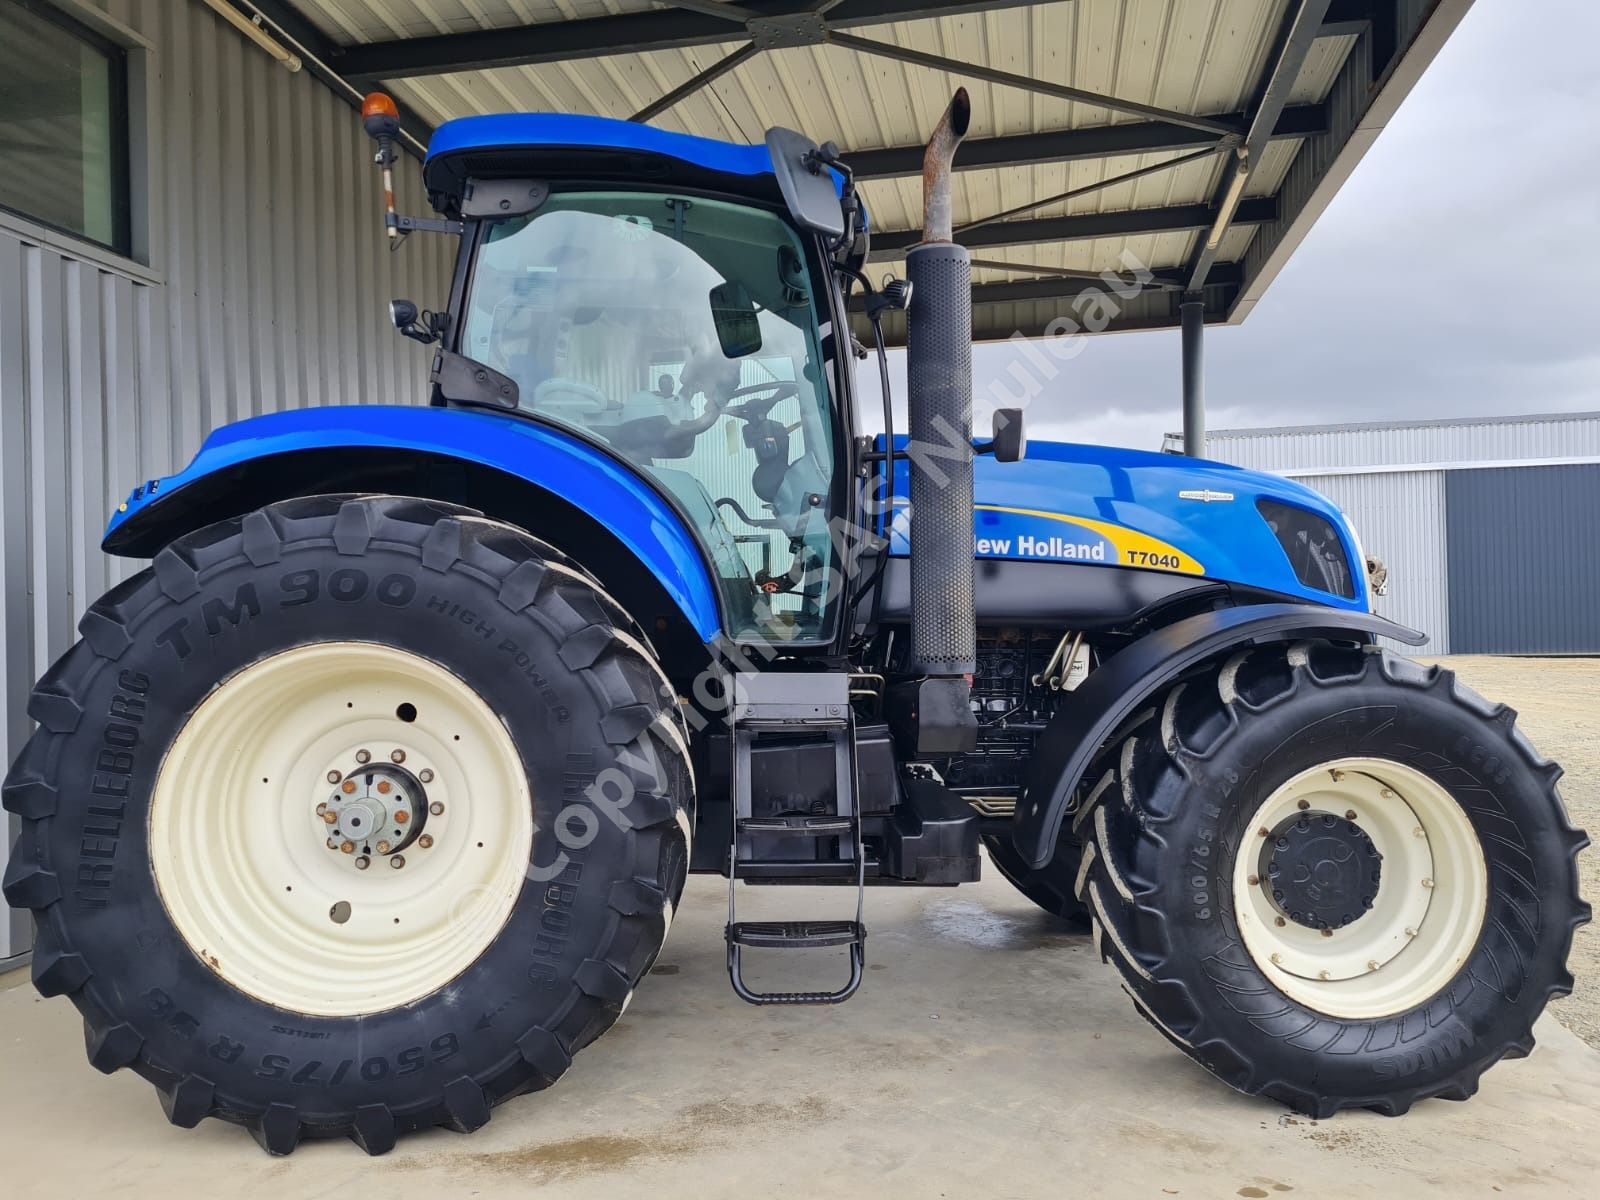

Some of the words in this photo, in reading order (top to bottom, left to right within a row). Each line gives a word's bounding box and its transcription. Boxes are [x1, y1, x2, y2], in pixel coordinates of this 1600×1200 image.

[974, 535, 1012, 555] ew
[1018, 535, 1105, 561] Holland
[1127, 550, 1180, 569] T7040
[153, 580, 262, 660] TM
[279, 567, 418, 609] 900
[427, 595, 497, 640] HIGH
[497, 638, 571, 724] POWER
[72, 668, 151, 914] TRELLEBORG
[1191, 829, 1214, 921] 600/65
[208, 1033, 249, 1065] R
[255, 1032, 461, 1087] 650/75
